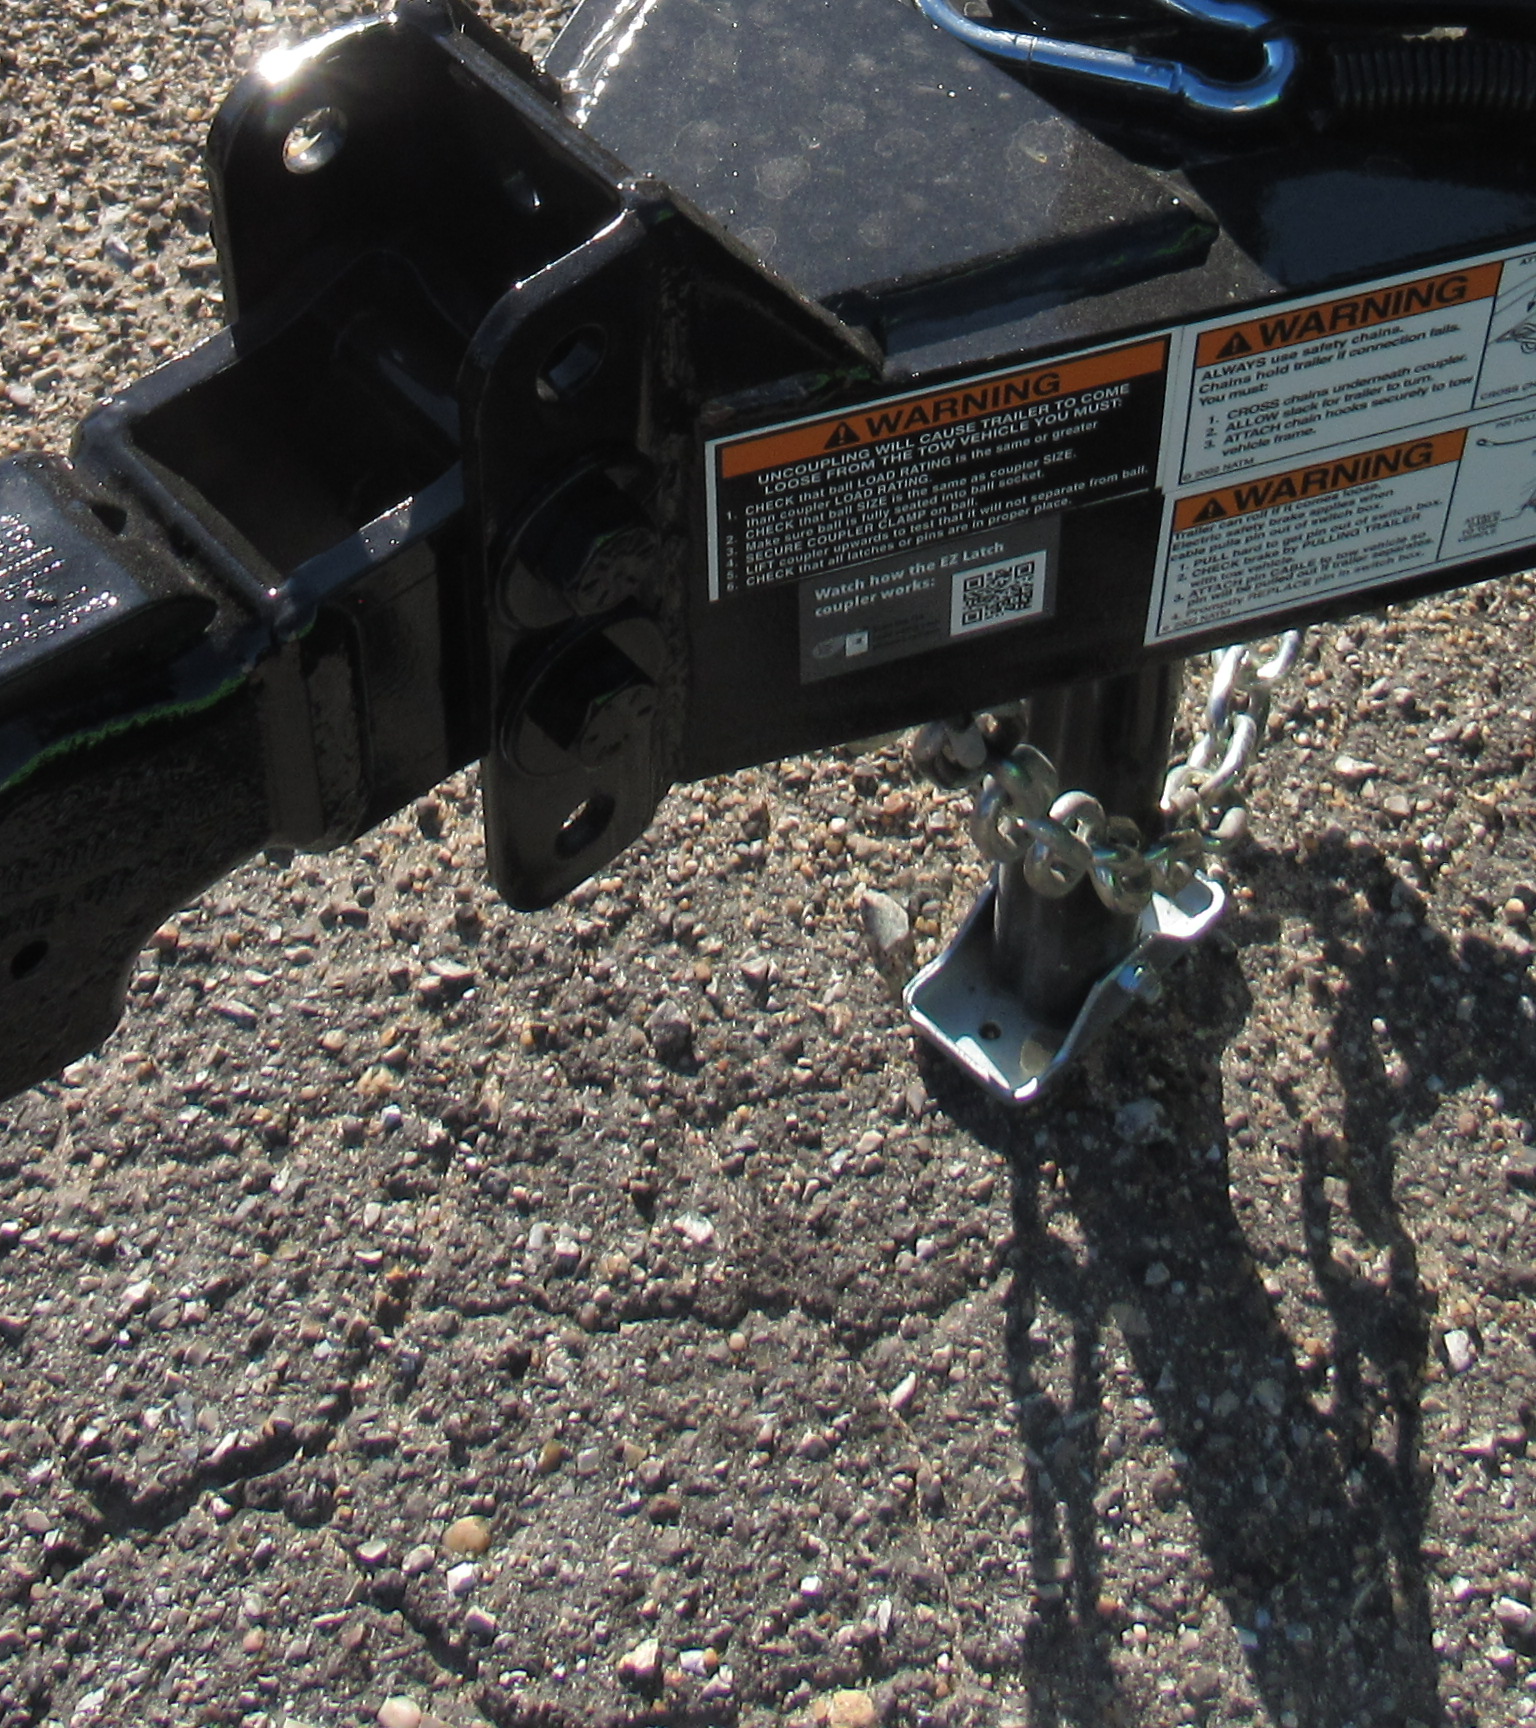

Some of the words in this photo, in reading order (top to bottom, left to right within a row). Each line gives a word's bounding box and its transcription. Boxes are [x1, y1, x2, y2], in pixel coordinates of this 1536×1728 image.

[1255, 272, 1470, 349] WARNING
[1198, 372, 1252, 394] Chains
[1255, 363, 1289, 380] hold
[1293, 351, 1334, 371] trailer
[1336, 348, 1346, 360] if
[1348, 328, 1426, 357] connection
[1201, 356, 1266, 381] ALWAYS
[1270, 350, 1298, 364] use
[1301, 336, 1348, 358] safety
[1226, 398, 1280, 420] CROSS
[1283, 386, 1329, 406] chains
[1332, 365, 1412, 394] underneath
[865, 370, 1062, 438] WARNING
[1198, 391, 1225, 407] You
[1223, 421, 1281, 445] ATTACH
[1283, 411, 1322, 430] chain
[1324, 399, 1368, 419] hooks
[1370, 384, 1429, 409] securely
[1431, 380, 1445, 392] to
[1447, 373, 1475, 388] tow
[1225, 410, 1279, 432] ALLOW
[1282, 400, 1319, 418] slack
[1321, 395, 1340, 408] for
[1343, 384, 1383, 403] trailer
[1385, 380, 1400, 392] to
[745, 494, 794, 516] CHECK
[798, 486, 826, 503] that
[828, 480, 852, 495] ball
[857, 469, 895, 488] LOAD
[900, 455, 951, 477] RATING
[955, 452, 967, 463] is
[971, 446, 991, 460] the
[995, 438, 1029, 453] same
[1034, 433, 1047, 444] or
[1051, 419, 1098, 441] greater
[757, 447, 869, 485] UNCOUPLING
[875, 436, 914, 456] WILL
[919, 421, 976, 445] CAUSE
[980, 403, 1049, 430] TRAILER
[1054, 396, 1076, 412] TO
[1080, 383, 1130, 405] COME
[765, 472, 820, 495] LOOSE
[826, 458, 875, 480] FROM
[879, 449, 912, 467] THE
[918, 438, 955, 457] TOW
[959, 420, 1029, 447] VEHICLE
[1033, 410, 1068, 428] YOU
[1073, 397, 1122, 419] MUST:
[1221, 435, 1271, 457] vehicle
[745, 519, 793, 540] CHECK
[798, 511, 825, 527] that
[828, 504, 852, 519] ball
[856, 495, 886, 512] SIZE
[891, 491, 902, 503] is
[907, 485, 927, 499] the
[932, 477, 966, 493] same
[970, 472, 985, 484] as
[989, 456, 1039, 481] coupler
[1042, 447, 1077, 466] SIZE.
[745, 535, 779, 552] Make
[784, 528, 812, 542] sure
[817, 519, 841, 534] ball
[846, 515, 857, 527] is
[861, 507, 888, 525] fully
[893, 495, 937, 515] seated
[941, 488, 966, 503] into
[970, 481, 994, 495] ball
[998, 468, 1044, 488] socket.
[746, 512, 774, 528] than
[780, 498, 830, 521] coupler
[834, 487, 872, 506] LOAD
[877, 472, 932, 495] RATING.
[1230, 439, 1435, 514] WARNING
[745, 560, 773, 576] LIFT
[778, 546, 828, 569] coupler
[833, 530, 888, 555] upwards
[893, 526, 904, 538] to
[910, 519, 933, 534] test
[938, 511, 962, 526] that
[967, 508, 975, 519] it
[980, 501, 1002, 516] will
[1005, 495, 1026, 509] not
[1029, 480, 1085, 505] separate
[1089, 472, 1117, 488] from
[1121, 464, 1149, 479] ball.
[745, 540, 802, 563] SECURE
[807, 522, 873, 548] COUPLER
[878, 509, 926, 530] CLAMP
[930, 505, 947, 516] on
[950, 495, 978, 511] ball.
[746, 566, 793, 587] CHECK
[798, 558, 825, 574] that
[827, 554, 842, 566] all
[847, 540, 894, 561] latches
[898, 538, 911, 548] or
[915, 528, 944, 545] pins
[947, 524, 968, 536] are
[972, 518, 983, 529] in
[987, 508, 1030, 527] proper
[1033, 495, 1072, 515] place.
[814, 576, 864, 602] Watch
[869, 566, 903, 587] how
[908, 558, 934, 577] the
[939, 551, 958, 568] EZ
[962, 539, 1003, 562] Latch
[814, 590, 876, 620] coupler
[880, 575, 934, 600] works:
